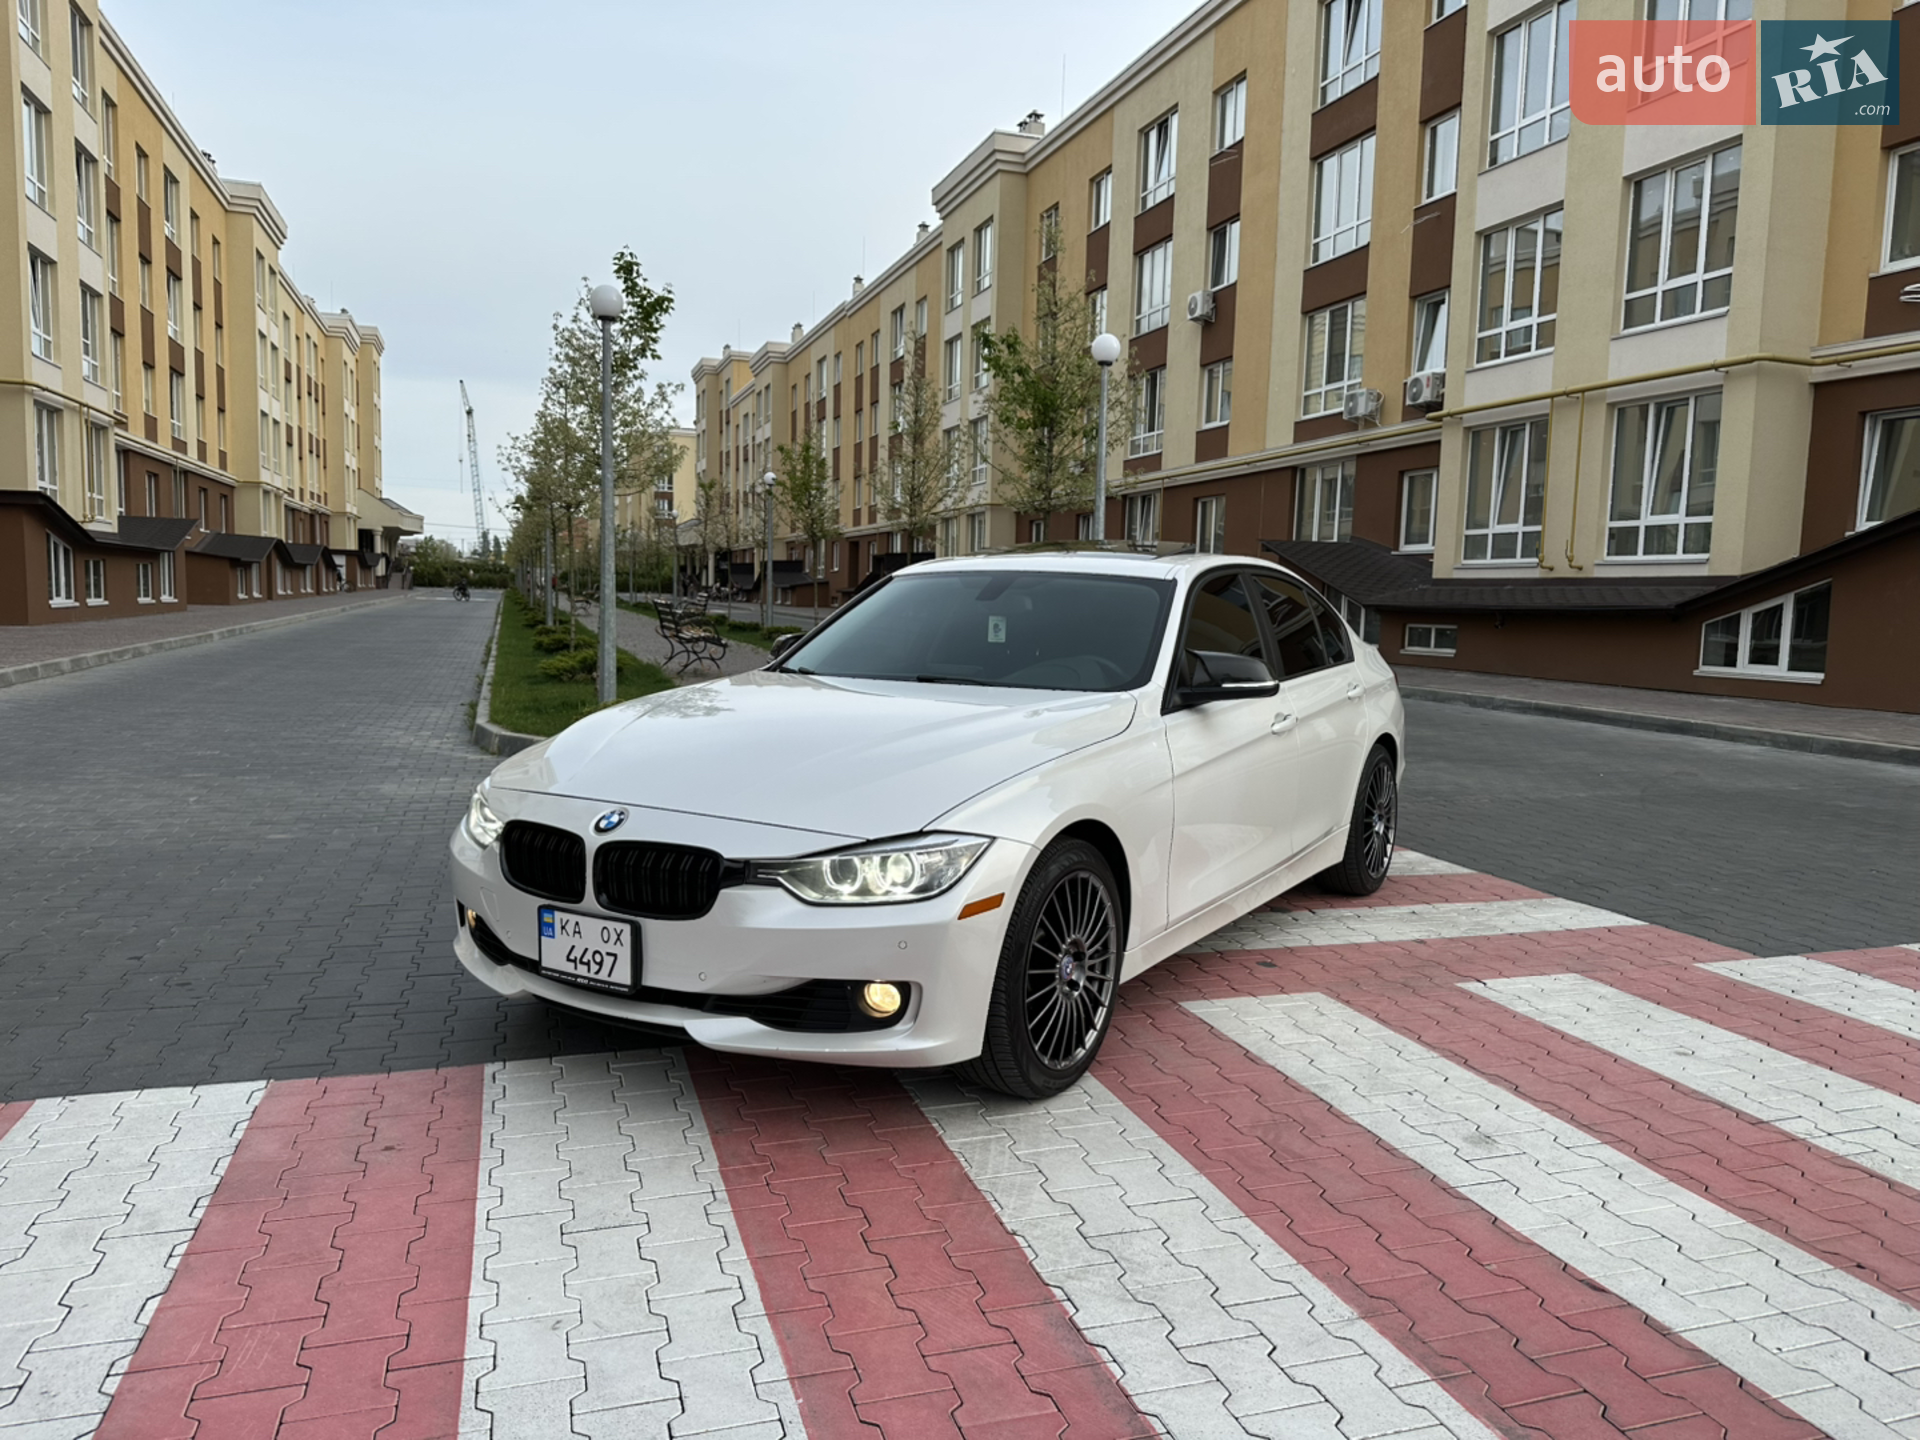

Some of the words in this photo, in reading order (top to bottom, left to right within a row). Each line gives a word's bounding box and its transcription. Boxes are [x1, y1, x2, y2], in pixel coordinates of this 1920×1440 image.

[543, 926, 554, 937] UA
[559, 917, 583, 939] KA
[600, 925, 625, 947] OX
[565, 944, 619, 979] 4497
